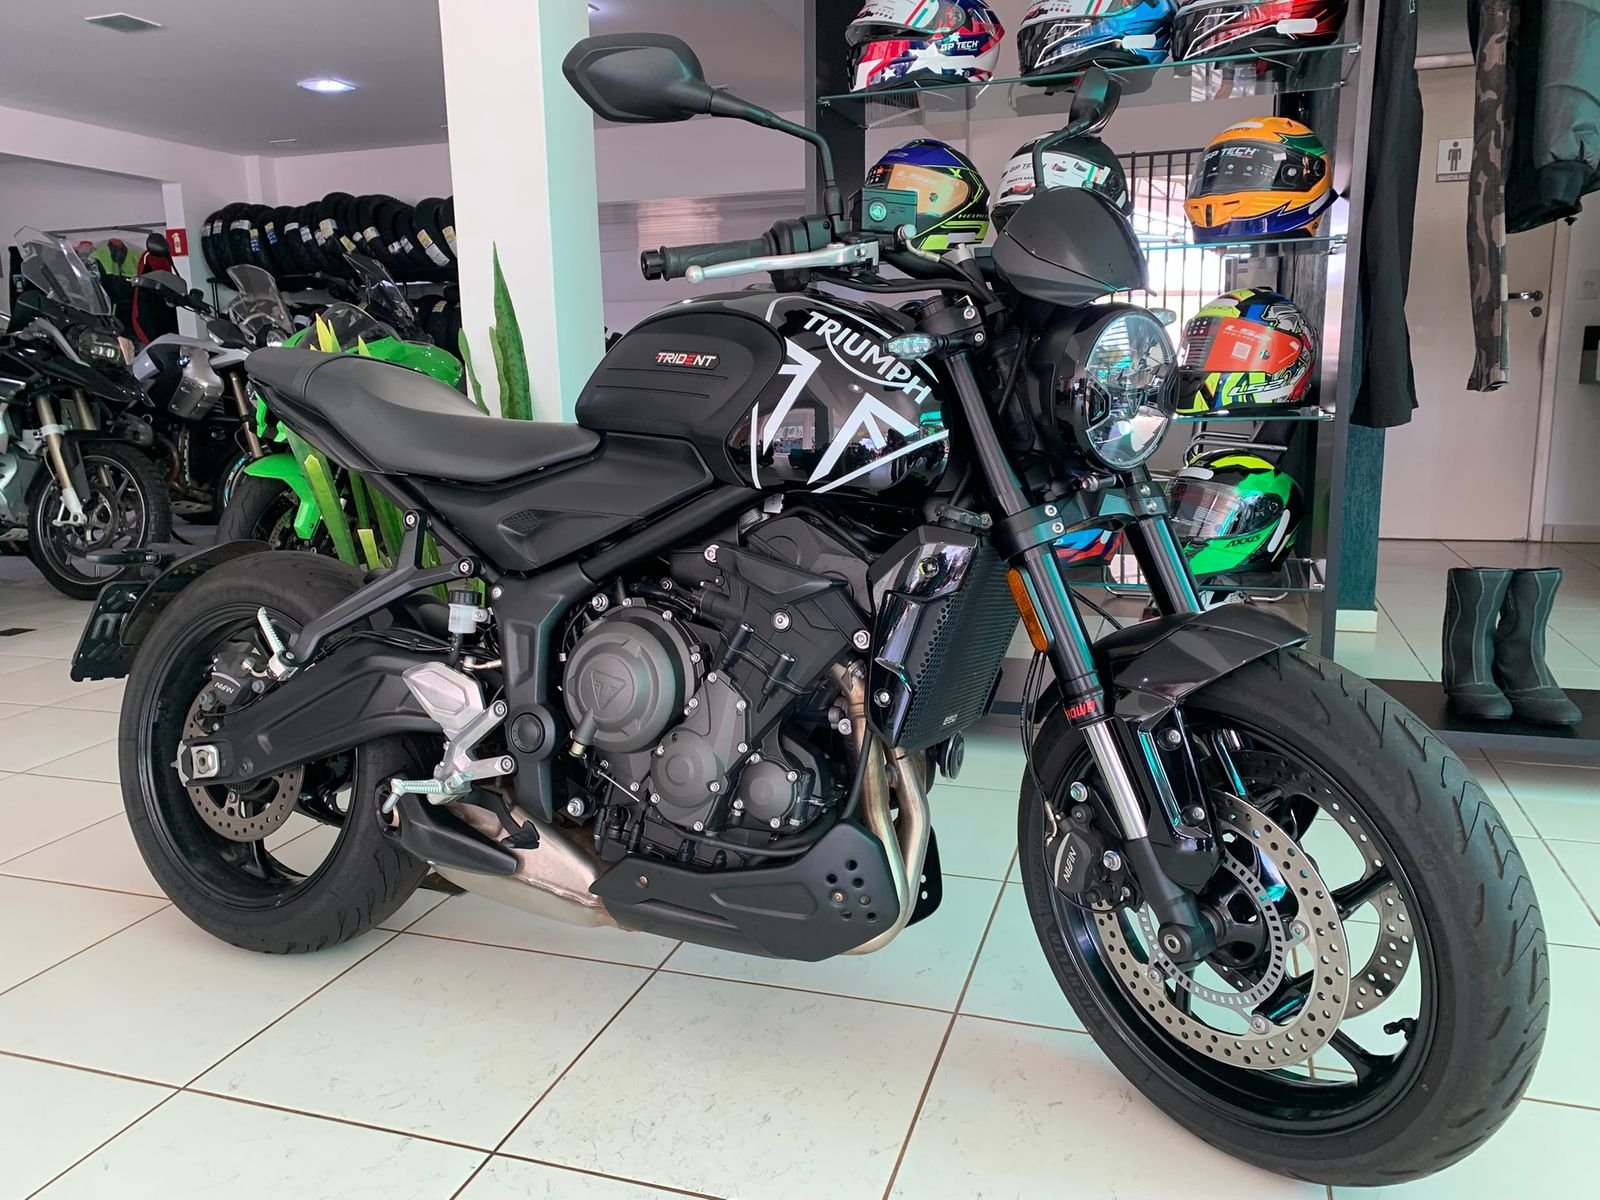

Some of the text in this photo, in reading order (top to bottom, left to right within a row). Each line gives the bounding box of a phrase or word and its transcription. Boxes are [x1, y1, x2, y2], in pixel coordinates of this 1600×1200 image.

[941, 42, 955, 51] GP
[956, 40, 979, 50] TECH
[1203, 146, 1257, 161] GP TECH
[656, 352, 716, 367] TRIDENT
[803, 311, 932, 405] TRIUMPH
[1228, 379, 1285, 396] LS2
[1225, 534, 1261, 548] AXXIS
[1063, 846, 1078, 884] NISSIN
[1049, 930, 1102, 1022] MICHELIN
